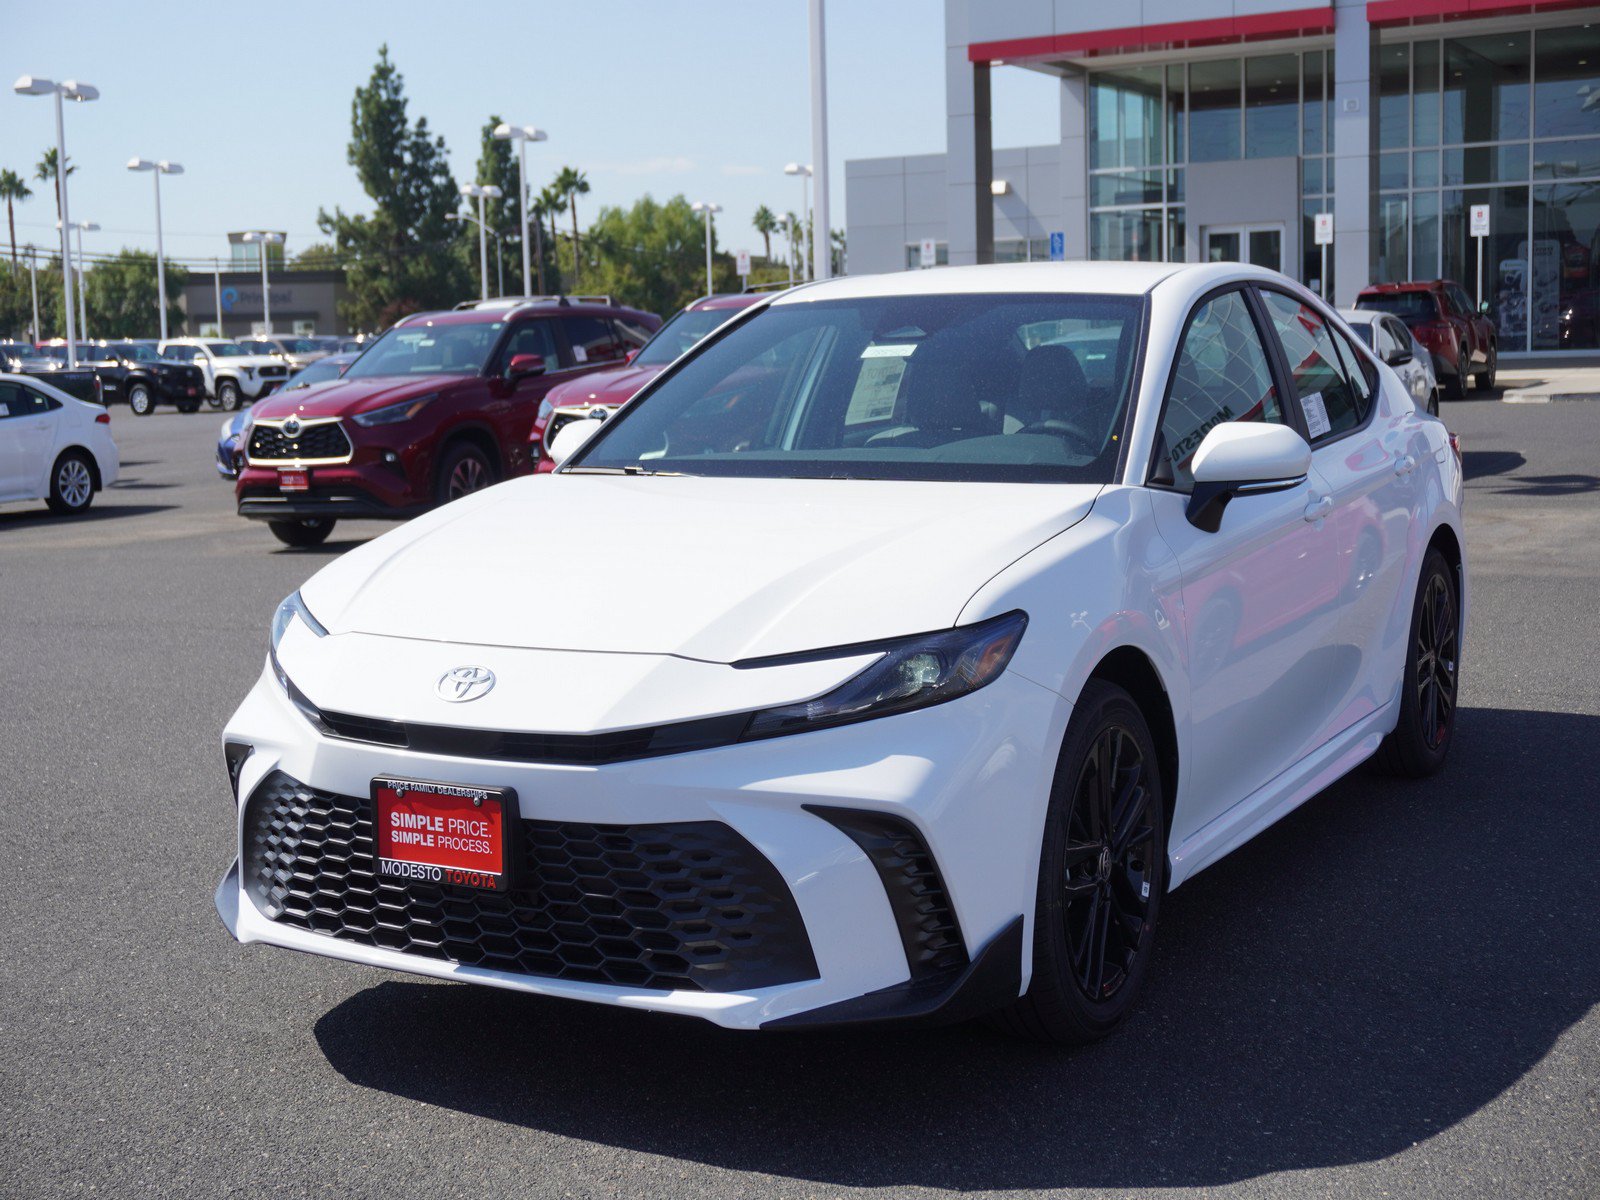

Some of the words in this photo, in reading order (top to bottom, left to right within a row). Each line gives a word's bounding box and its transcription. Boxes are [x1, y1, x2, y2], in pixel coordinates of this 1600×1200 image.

[240, 289, 293, 305] Prinipal
[387, 781, 410, 791] PRICE
[410, 783, 437, 794] FAMILY
[437, 786, 488, 800] DEALERSHIPS
[390, 811, 444, 833] SIMPLE
[448, 818, 492, 838] PRICE.
[391, 830, 435, 847] SIMPLE
[437, 835, 493, 854] PROCESS.
[381, 860, 442, 881] MODESTO
[445, 869, 497, 889] TOYOTA
